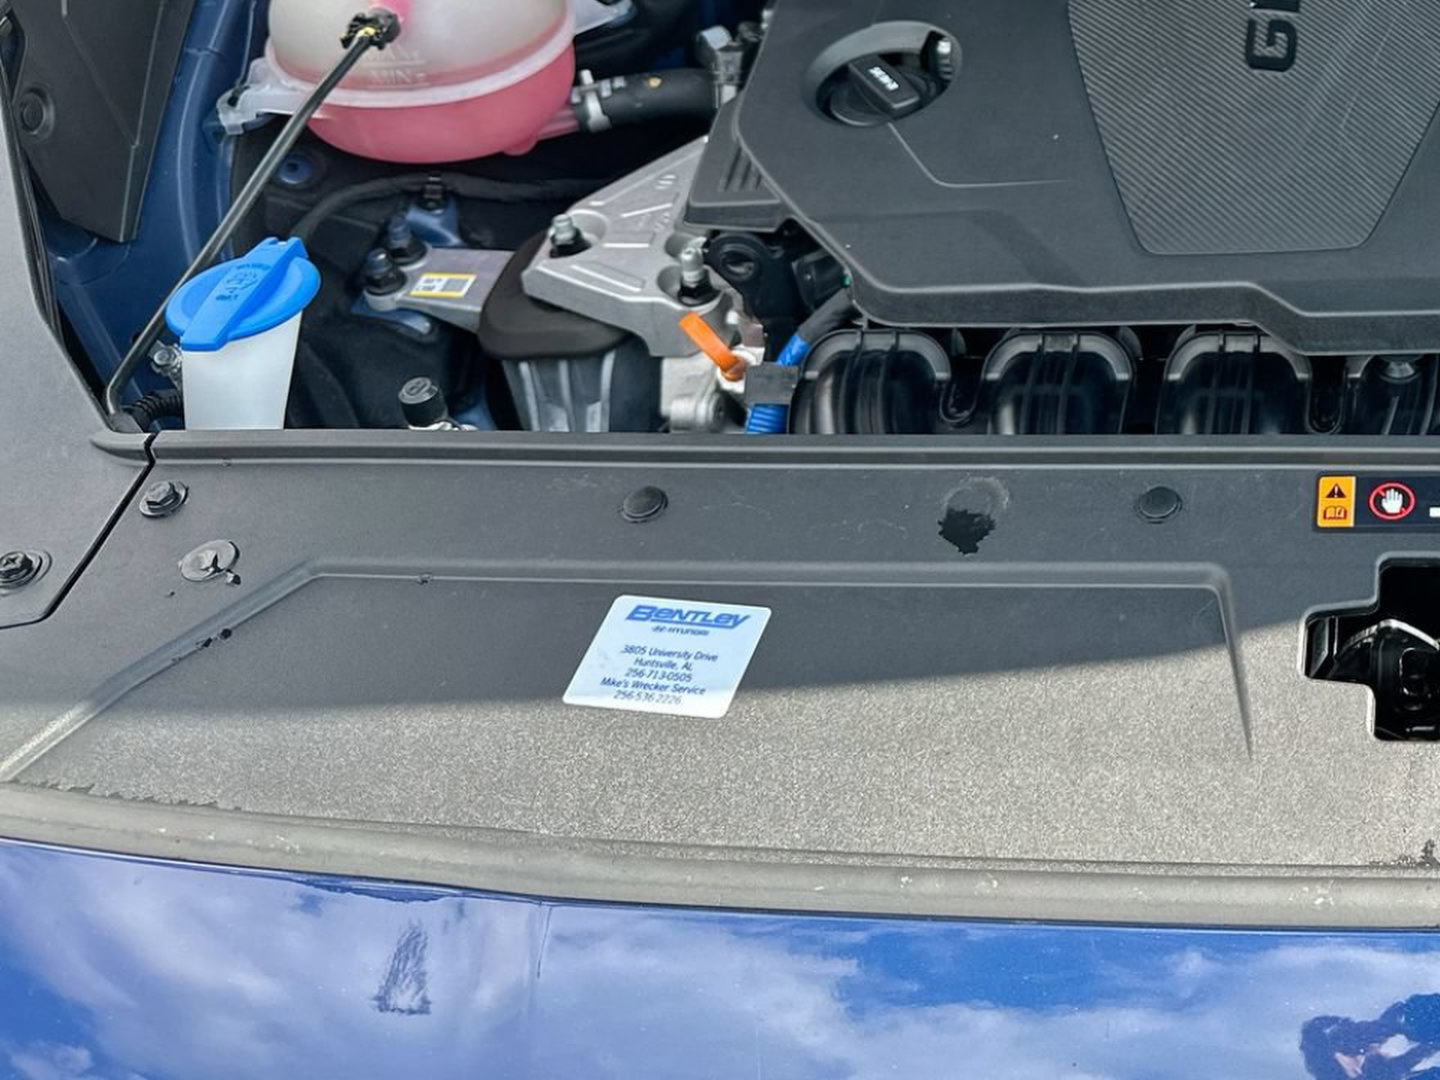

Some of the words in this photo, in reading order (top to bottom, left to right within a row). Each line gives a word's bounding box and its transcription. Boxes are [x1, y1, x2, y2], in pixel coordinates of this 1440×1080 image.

[622, 644, 647, 655] 3805
[648, 647, 693, 661] University
[694, 651, 719, 662] Drive
[633, 657, 678, 670] Huntsville,
[681, 661, 694, 672] AL
[599, 676, 630, 688] Mike's
[631, 680, 669, 691] Wrecker
[671, 683, 706, 695] Service
